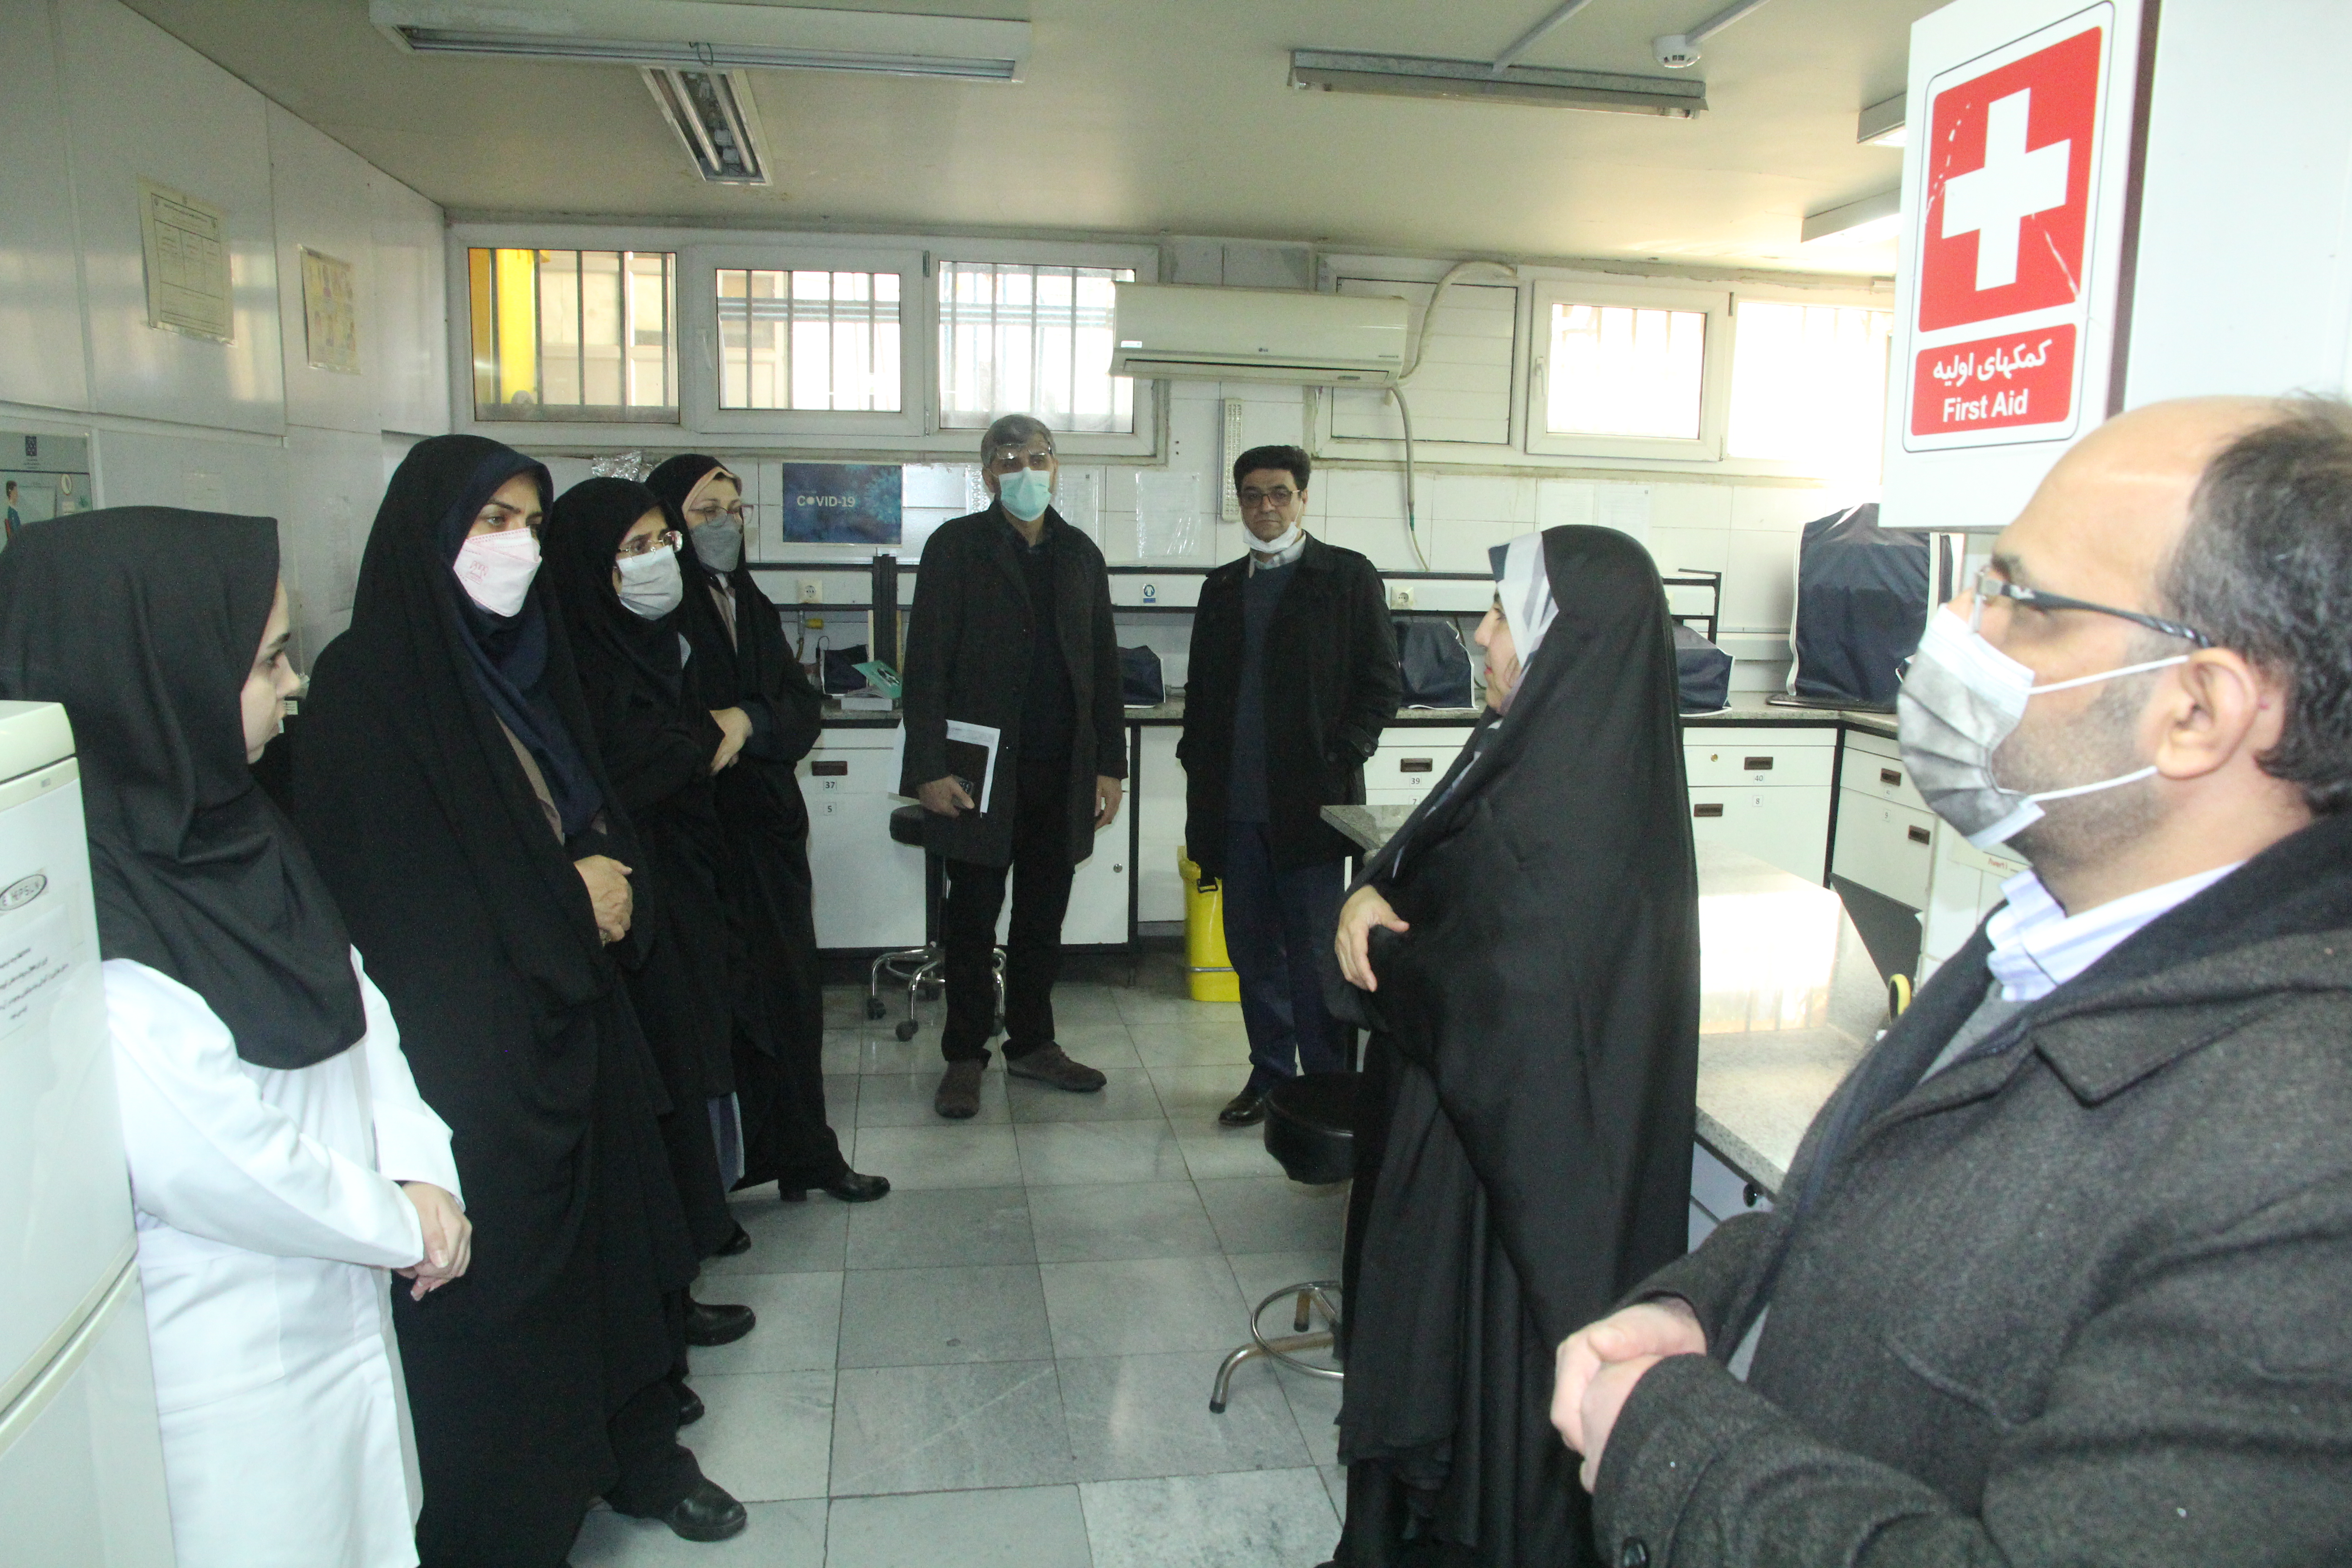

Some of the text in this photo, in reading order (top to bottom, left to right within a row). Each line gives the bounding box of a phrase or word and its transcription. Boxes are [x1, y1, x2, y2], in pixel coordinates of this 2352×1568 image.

[1932, 338, 2053, 387] کمکهای اولیه
[1942, 388, 2029, 422] First Aid
[797, 495, 855, 507] COVID-19
